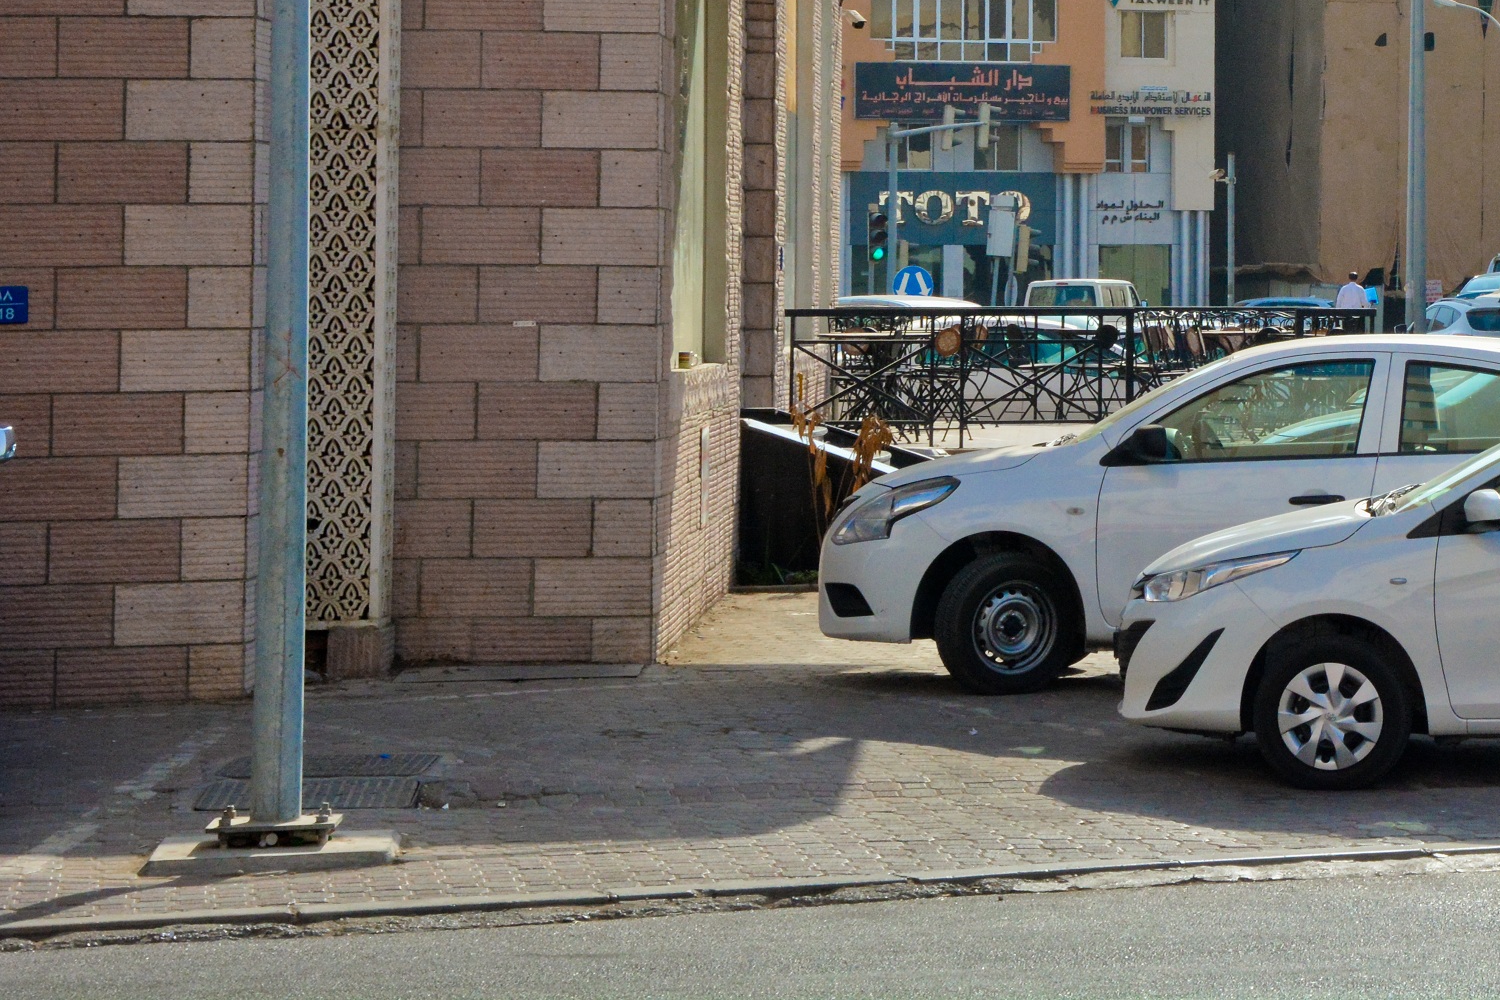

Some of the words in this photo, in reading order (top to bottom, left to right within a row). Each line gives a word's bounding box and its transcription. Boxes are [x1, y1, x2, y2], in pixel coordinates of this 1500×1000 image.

[896, 66, 999, 90] الشباب
[1004, 69, 1033, 91] دار
[1131, 106, 1172, 115] MANPOWER
[1175, 107, 1211, 116] SERVICES
[1096, 200, 1124, 211] لمواد
[1126, 200, 1164, 212] الحلول
[1134, 212, 1160, 223] البناء
